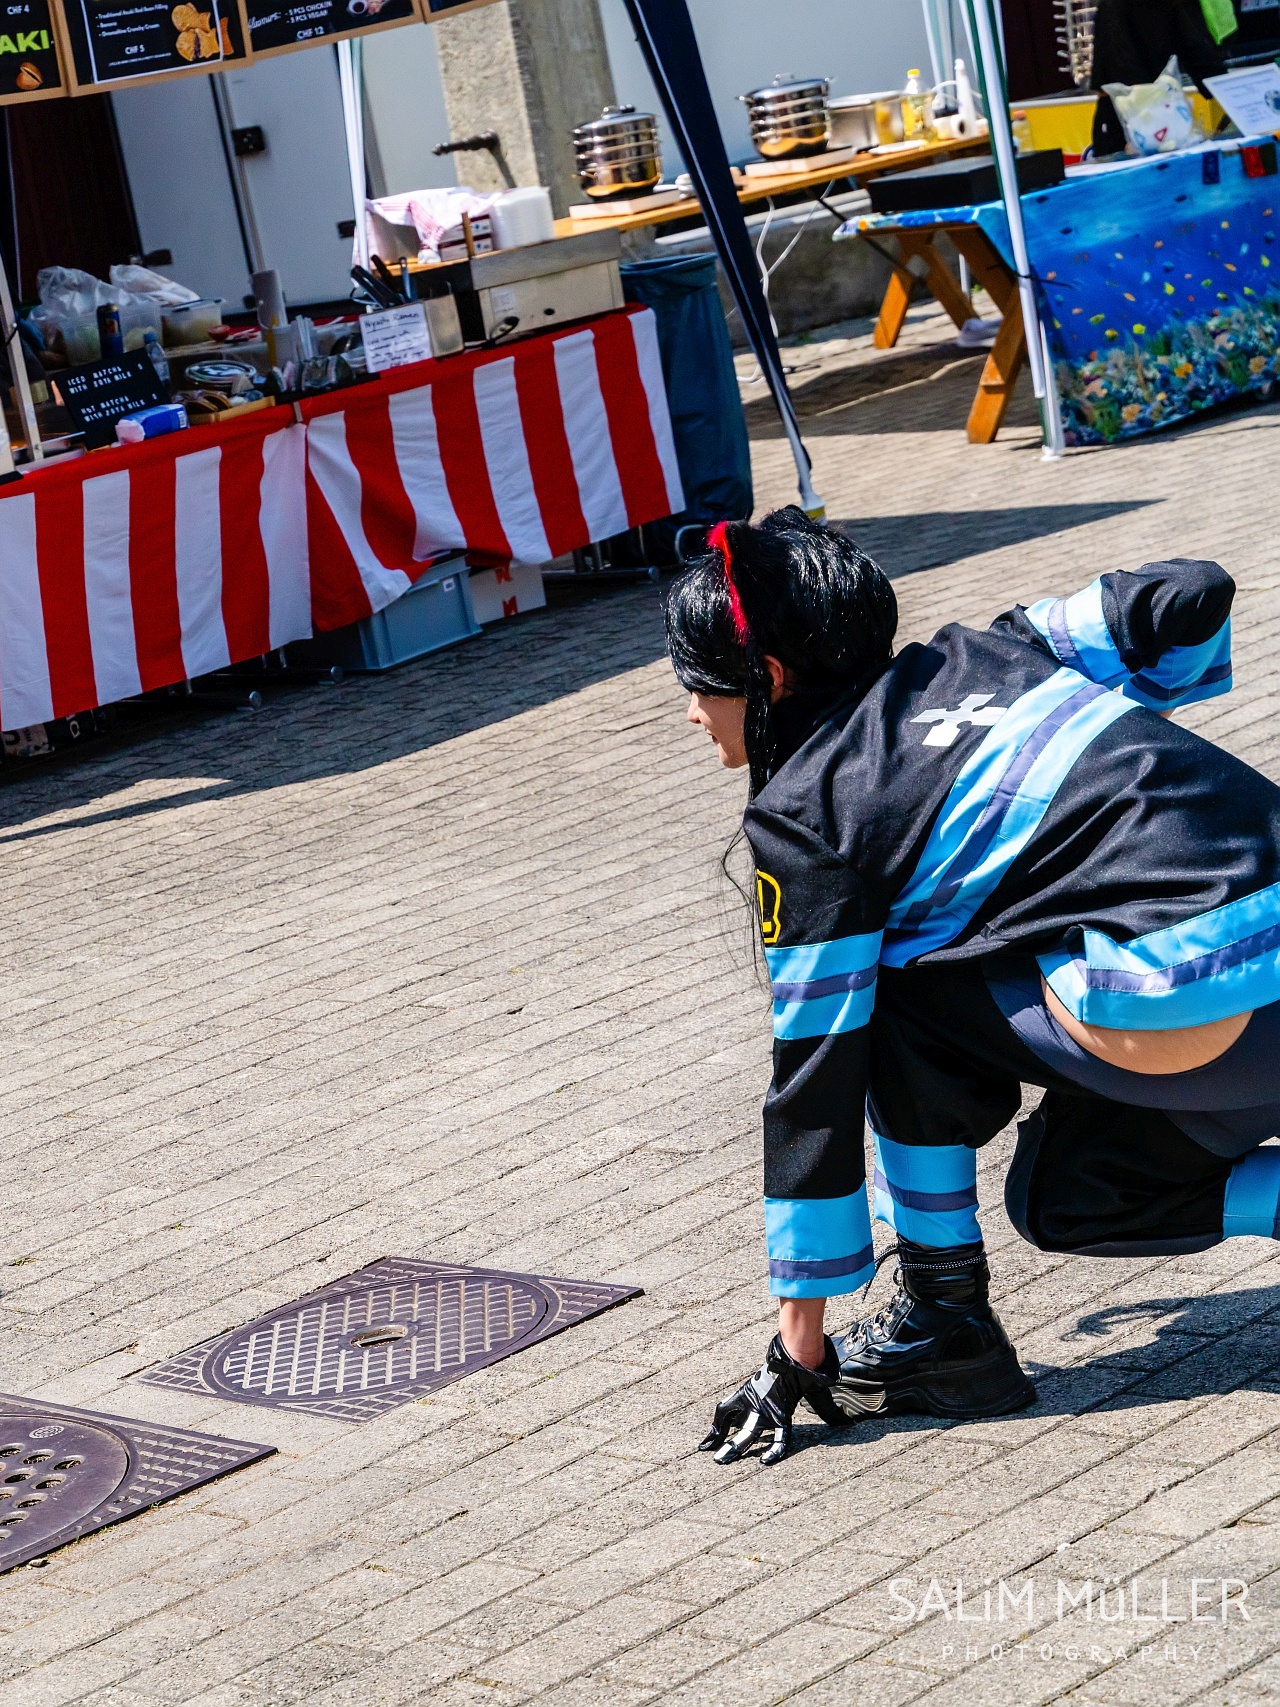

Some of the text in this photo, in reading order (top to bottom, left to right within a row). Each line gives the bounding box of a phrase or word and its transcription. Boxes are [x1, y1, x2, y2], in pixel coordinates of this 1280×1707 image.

[6, 4, 30, 15] CHF 4
[296, 25, 325, 39] CHF 12
[125, 44, 146, 55] CHF 5
[67, 375, 86, 386] ICED
[92, 365, 122, 379] MATCHA
[69, 371, 132, 394] WITH SOYA MILK
[81, 405, 96, 415] HOT
[100, 395, 130, 409] MATCHA
[83, 399, 146, 423] WITH SOYA MILK
